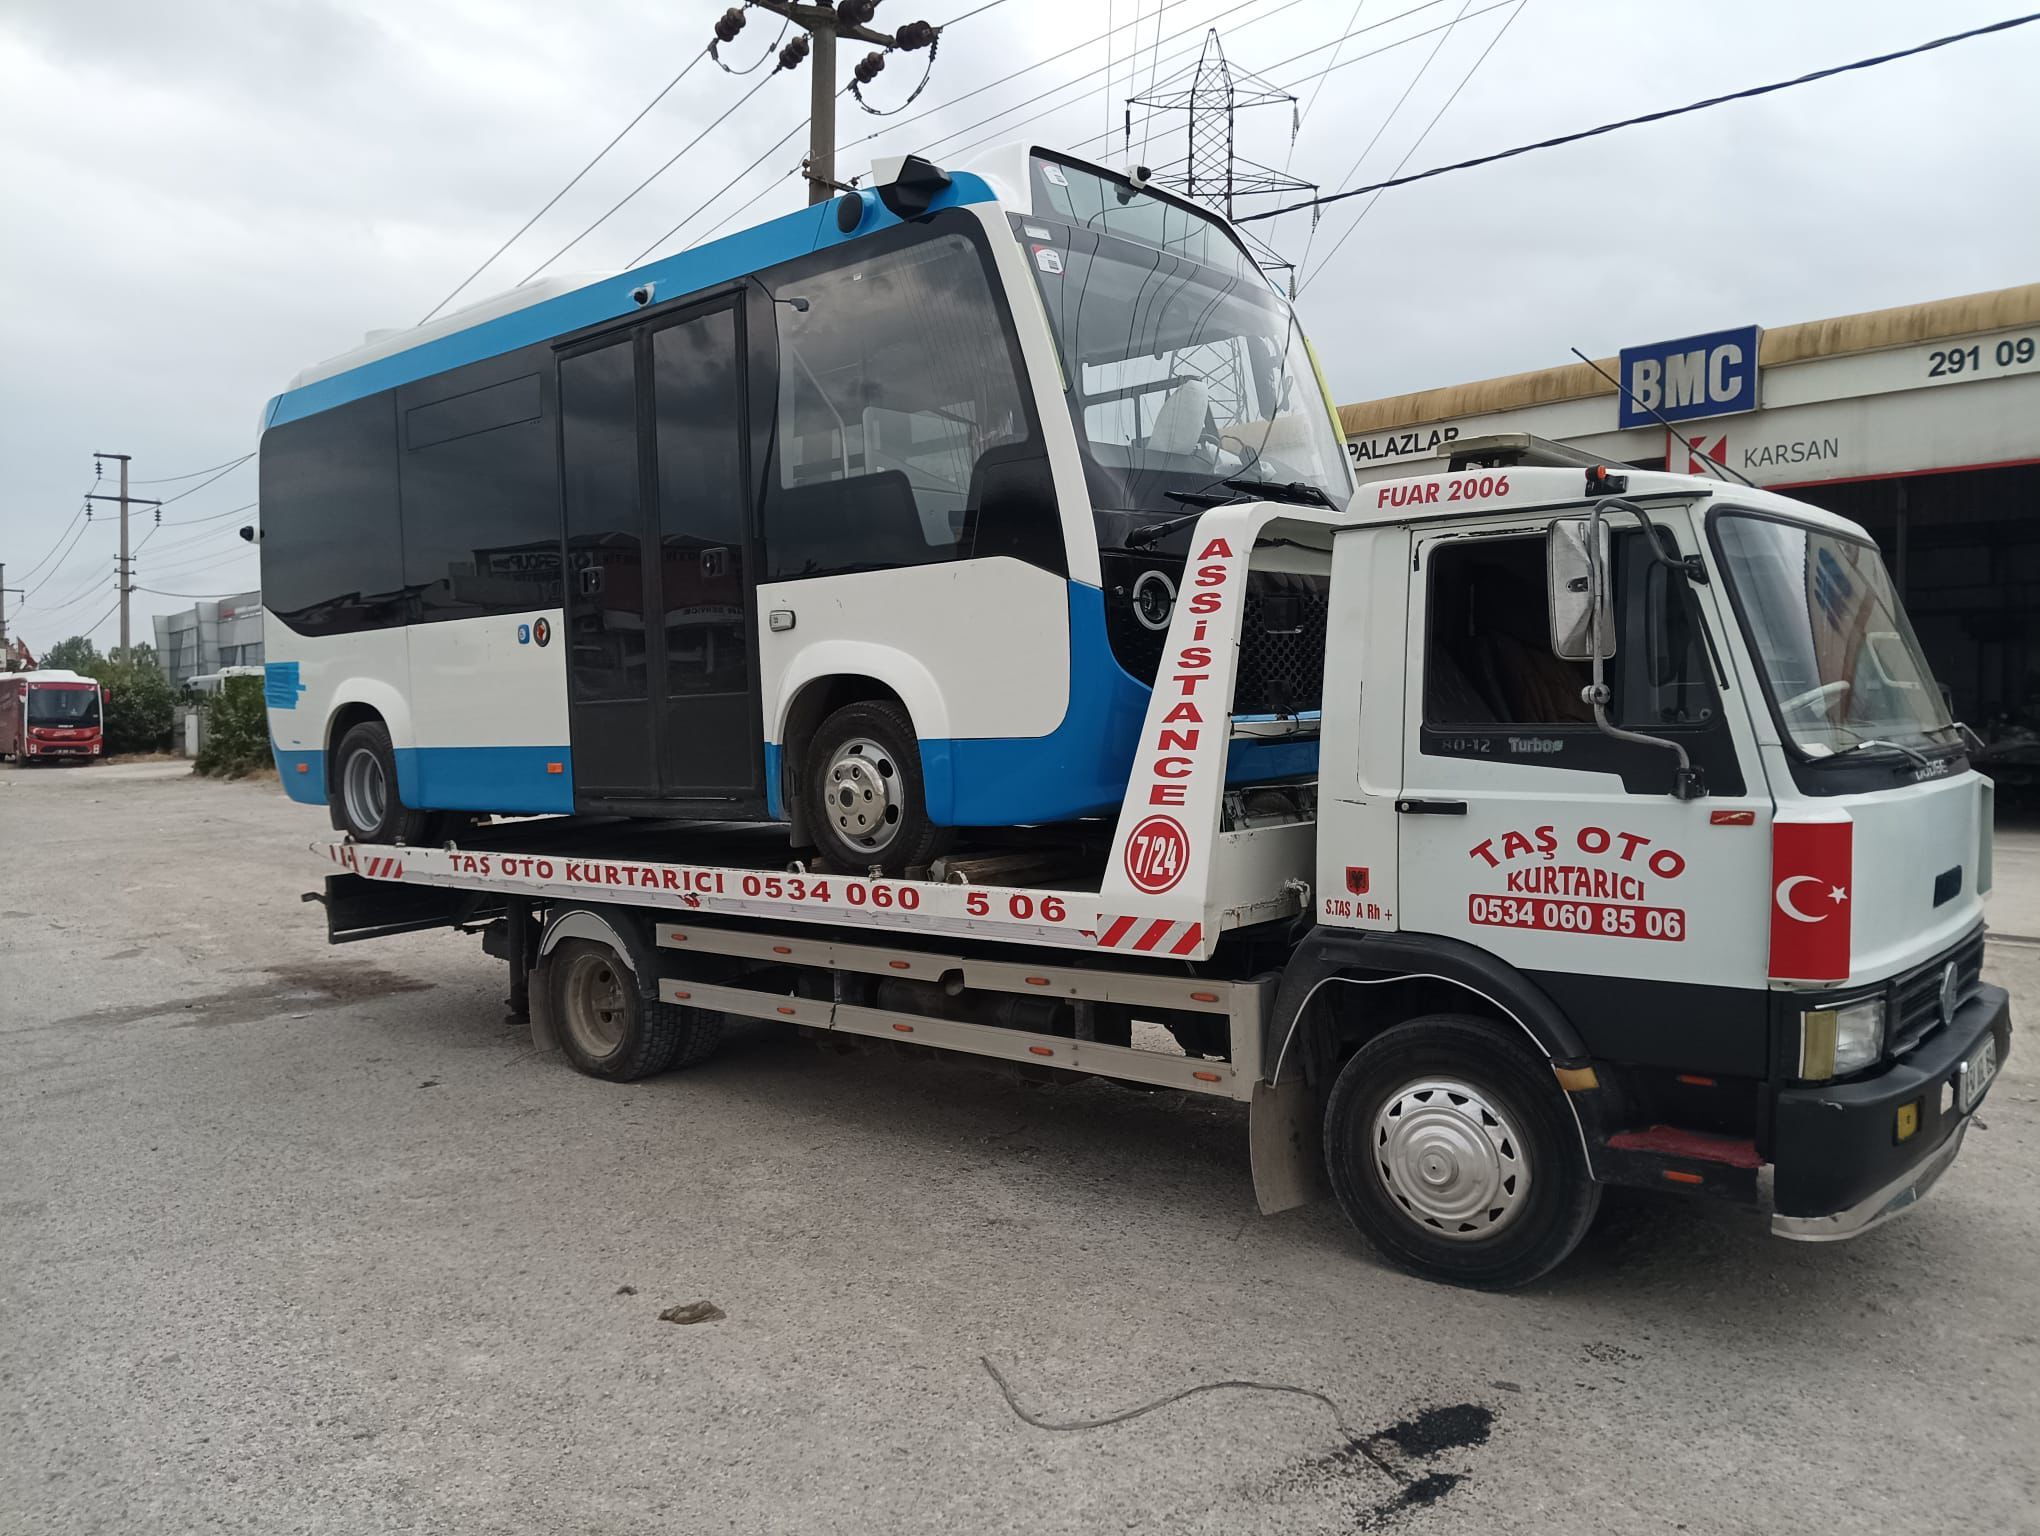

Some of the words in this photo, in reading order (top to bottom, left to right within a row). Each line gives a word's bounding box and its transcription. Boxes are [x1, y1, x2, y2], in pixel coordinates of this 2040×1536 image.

[1928, 345, 1980, 377] 291
[1996, 337, 2035, 367] 09
[1632, 344, 1742, 414] BMC
[1744, 438, 1839, 468] KARSAN
[1377, 482, 1440, 508] FUAR
[1447, 475, 1510, 501] 2006
[1136, 836, 1177, 879] 7/24
[1469, 825, 1558, 868] TAŞ
[1577, 826, 1686, 879] OTO
[449, 854, 491, 877] TAŞ
[502, 858, 553, 879] OTO
[566, 862, 725, 894] KURTARICI
[742, 875, 831, 903] 0534
[846, 883, 920, 910] 060
[1009, 894, 1066, 922] 06
[1507, 865, 1645, 901] KURTARICI
[1367, 903, 1380, 920] Rh
[1472, 897, 1535, 925] 0534
[1543, 903, 1592, 930] 060
[1601, 908, 1636, 934] 85
[1646, 911, 1681, 938] 06
